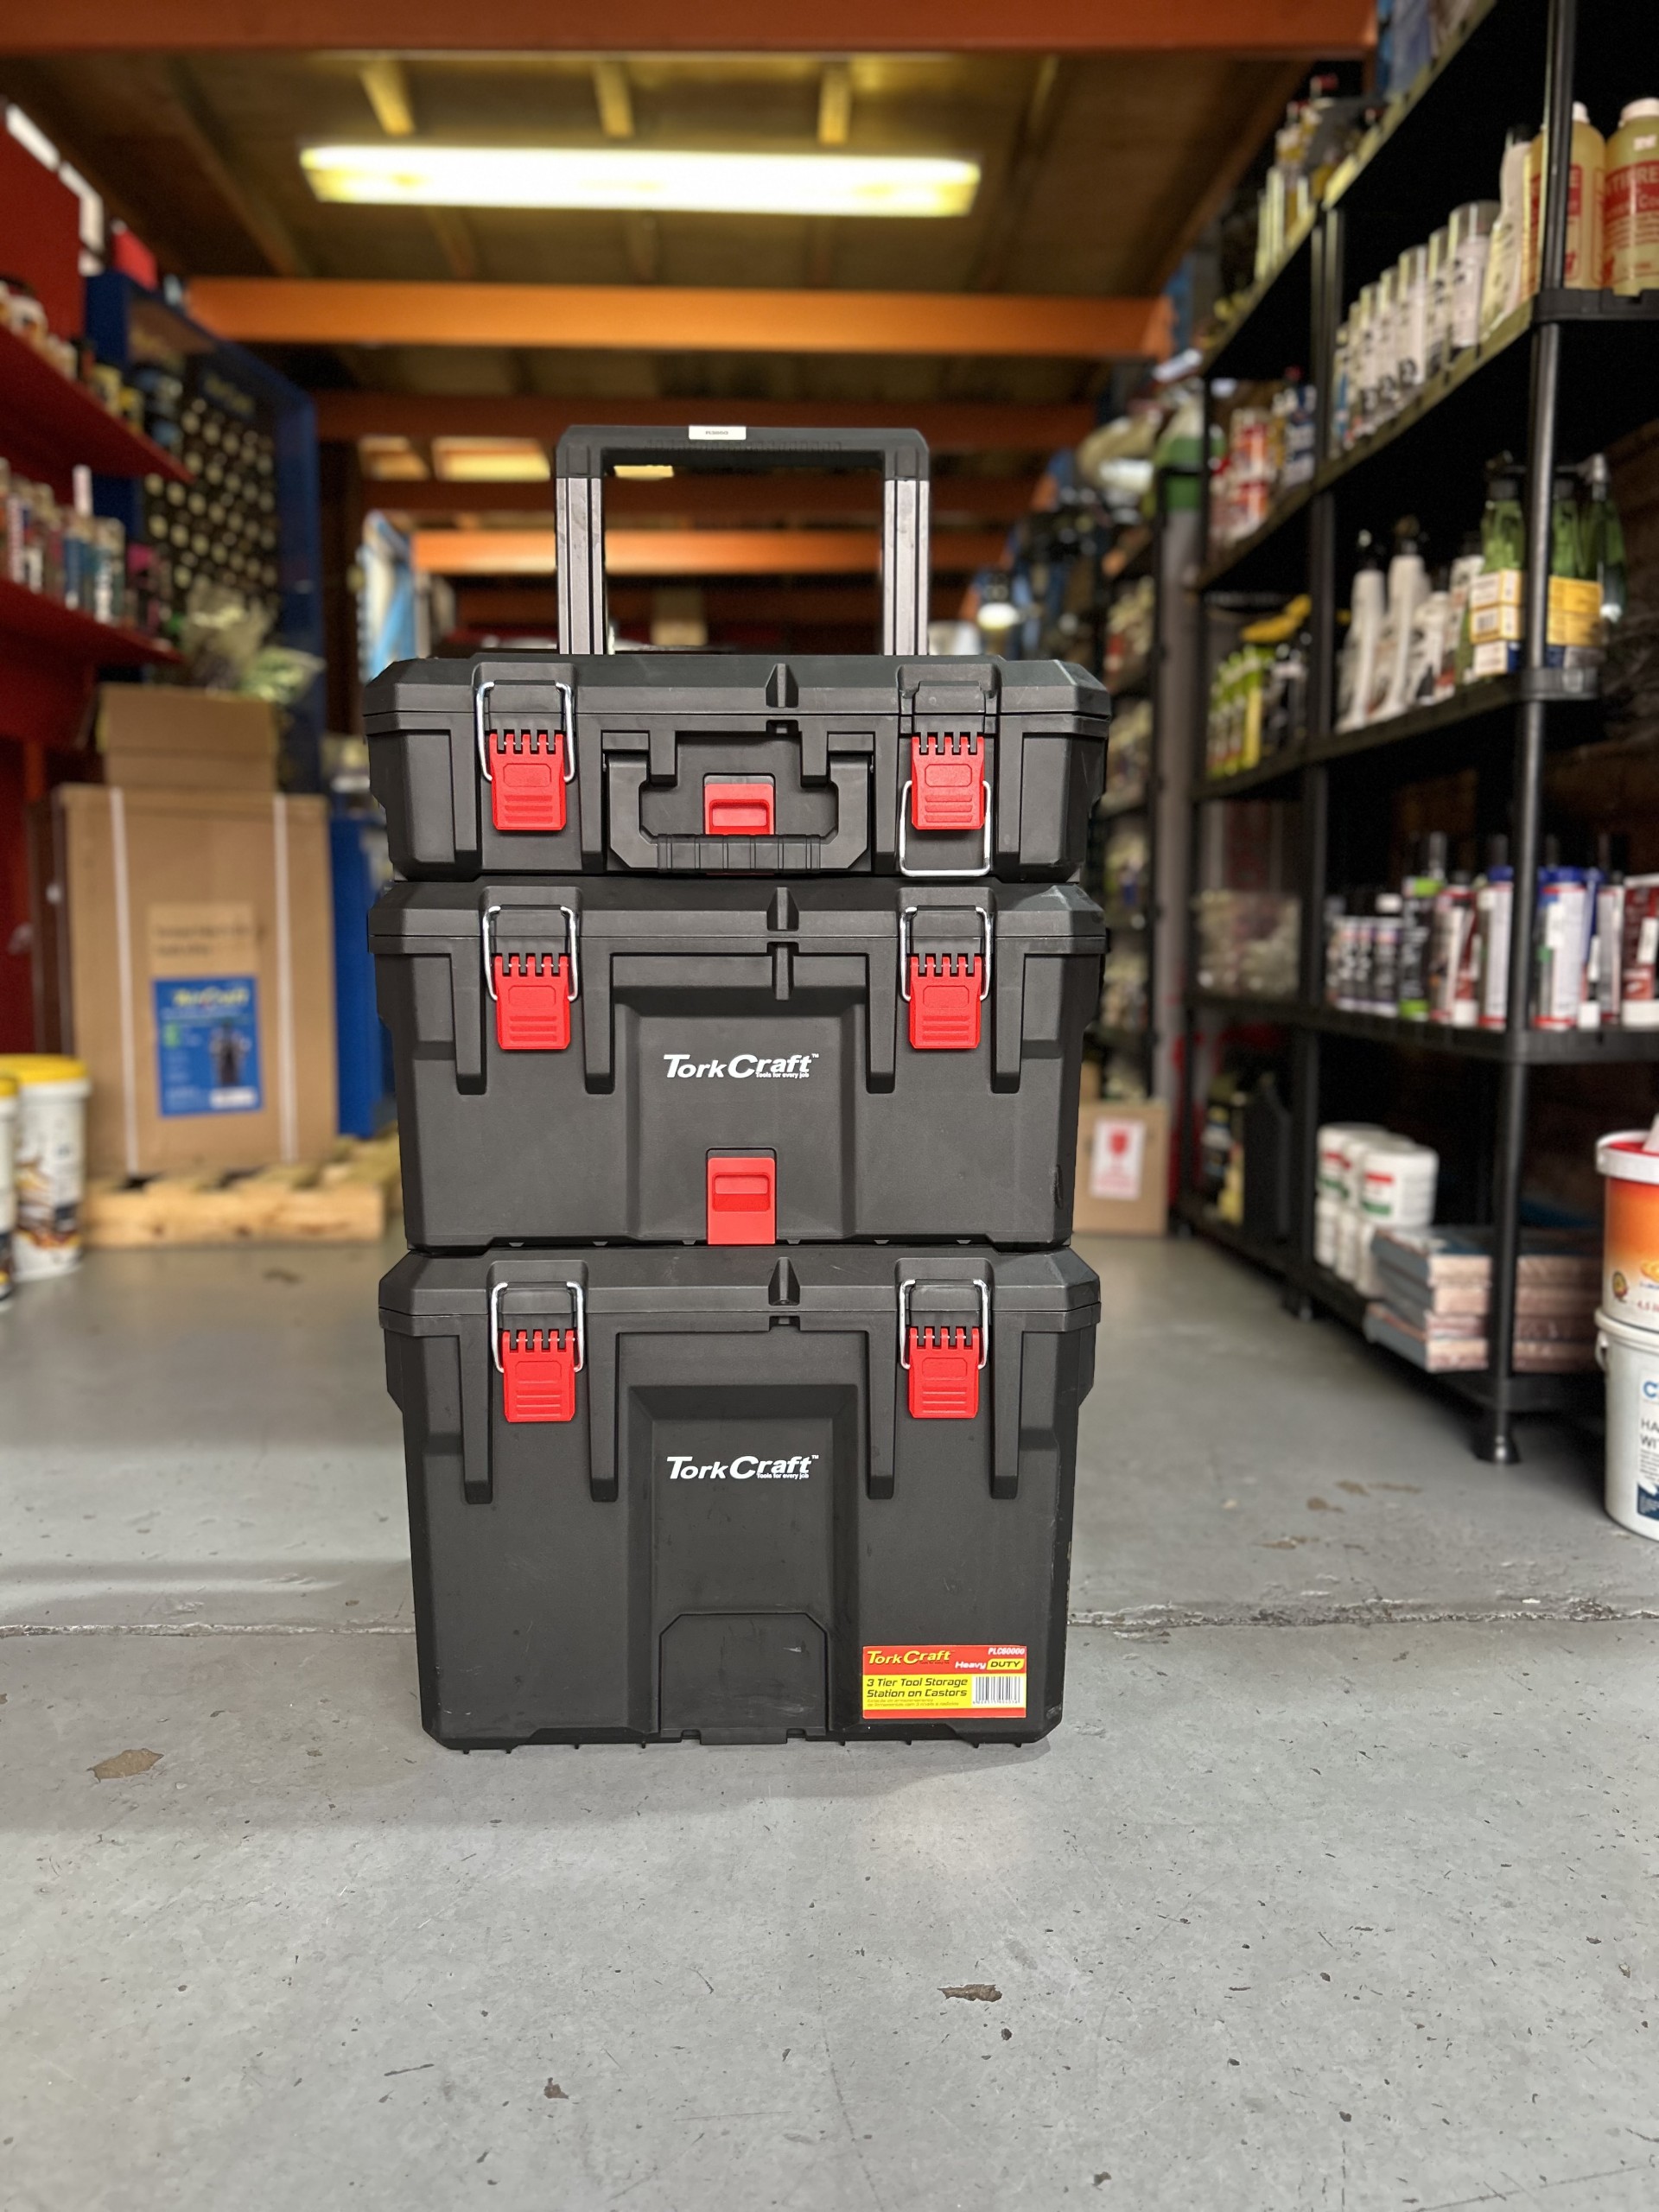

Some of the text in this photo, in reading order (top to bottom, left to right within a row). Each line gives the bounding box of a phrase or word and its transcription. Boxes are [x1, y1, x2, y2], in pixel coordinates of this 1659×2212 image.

[955, 1661, 987, 1670] Heavy
[867, 1677, 969, 1688] 3 Tier Tool Storage
[867, 1688, 906, 1698] Station
[925, 1688, 968, 1697] Castors
